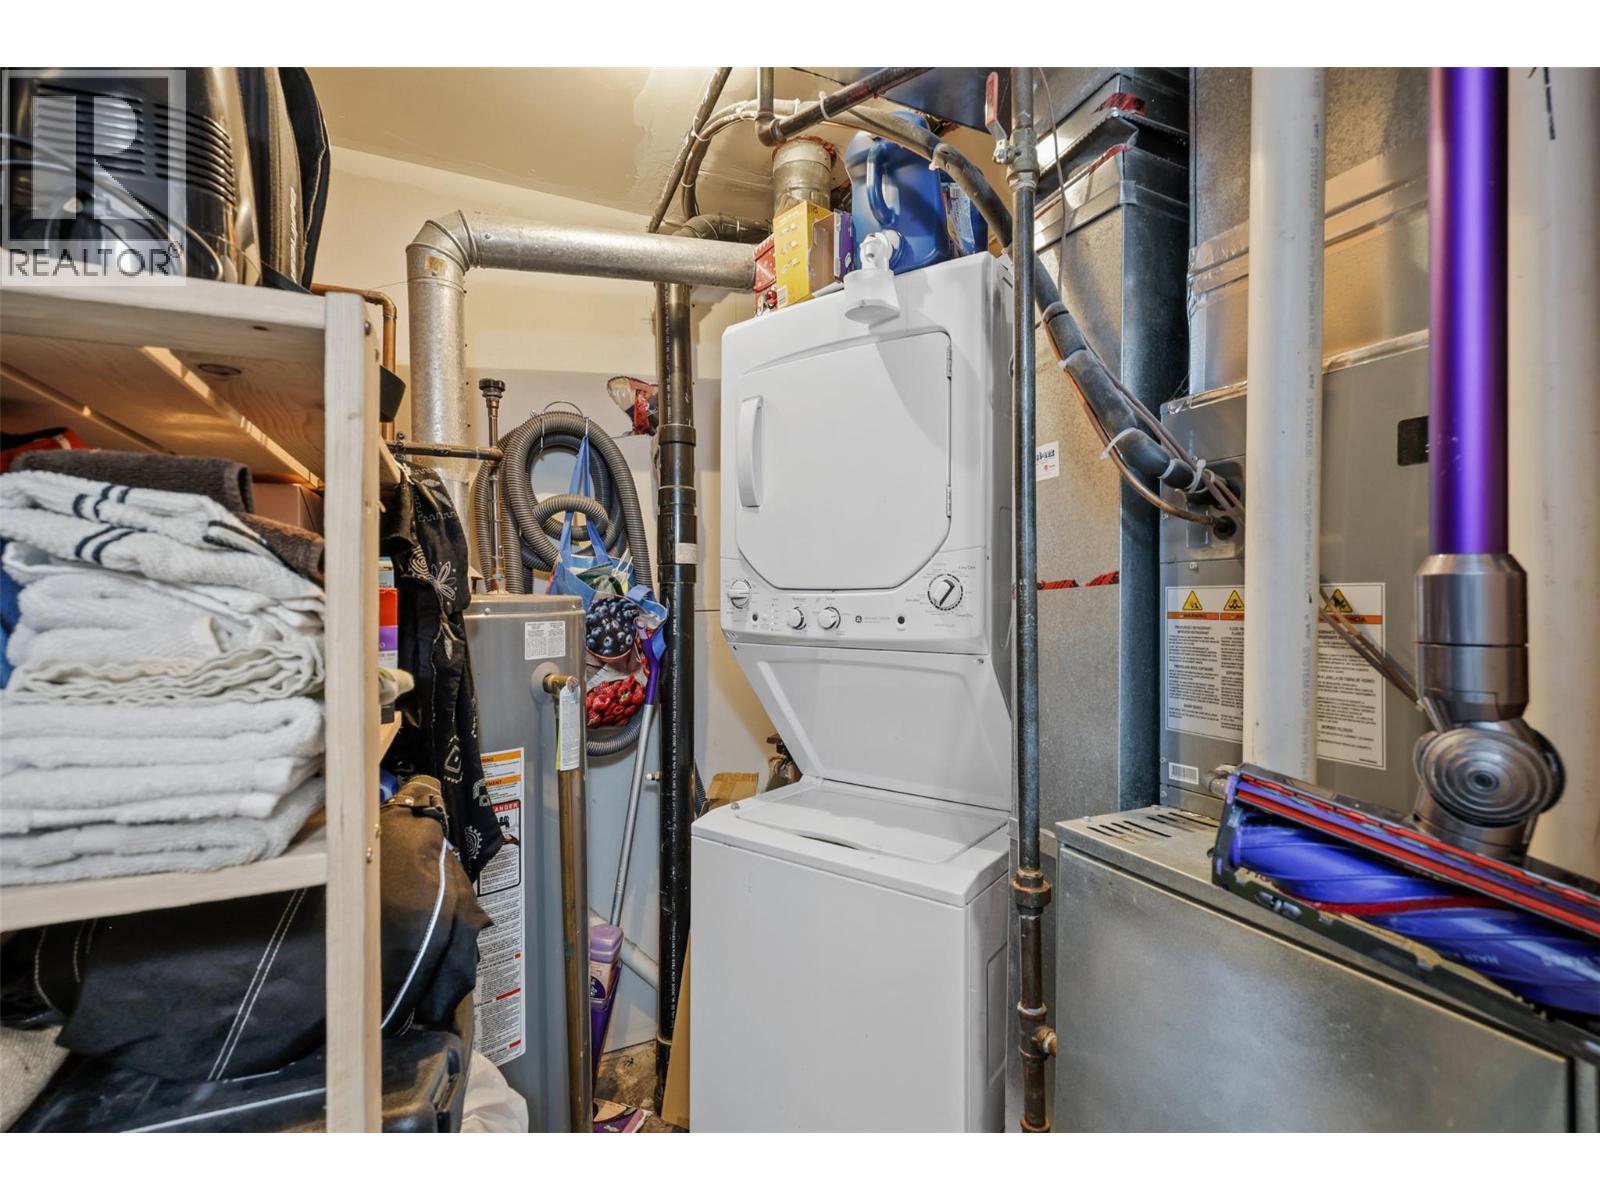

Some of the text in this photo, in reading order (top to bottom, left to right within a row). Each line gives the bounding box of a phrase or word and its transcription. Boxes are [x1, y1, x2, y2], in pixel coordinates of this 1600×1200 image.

[1311, 147, 1319, 189] SYSTEM
[1305, 397, 1313, 439] SYSTEM
[1301, 647, 1310, 688] SYSTEM
[493, 802, 519, 812] ANGER
